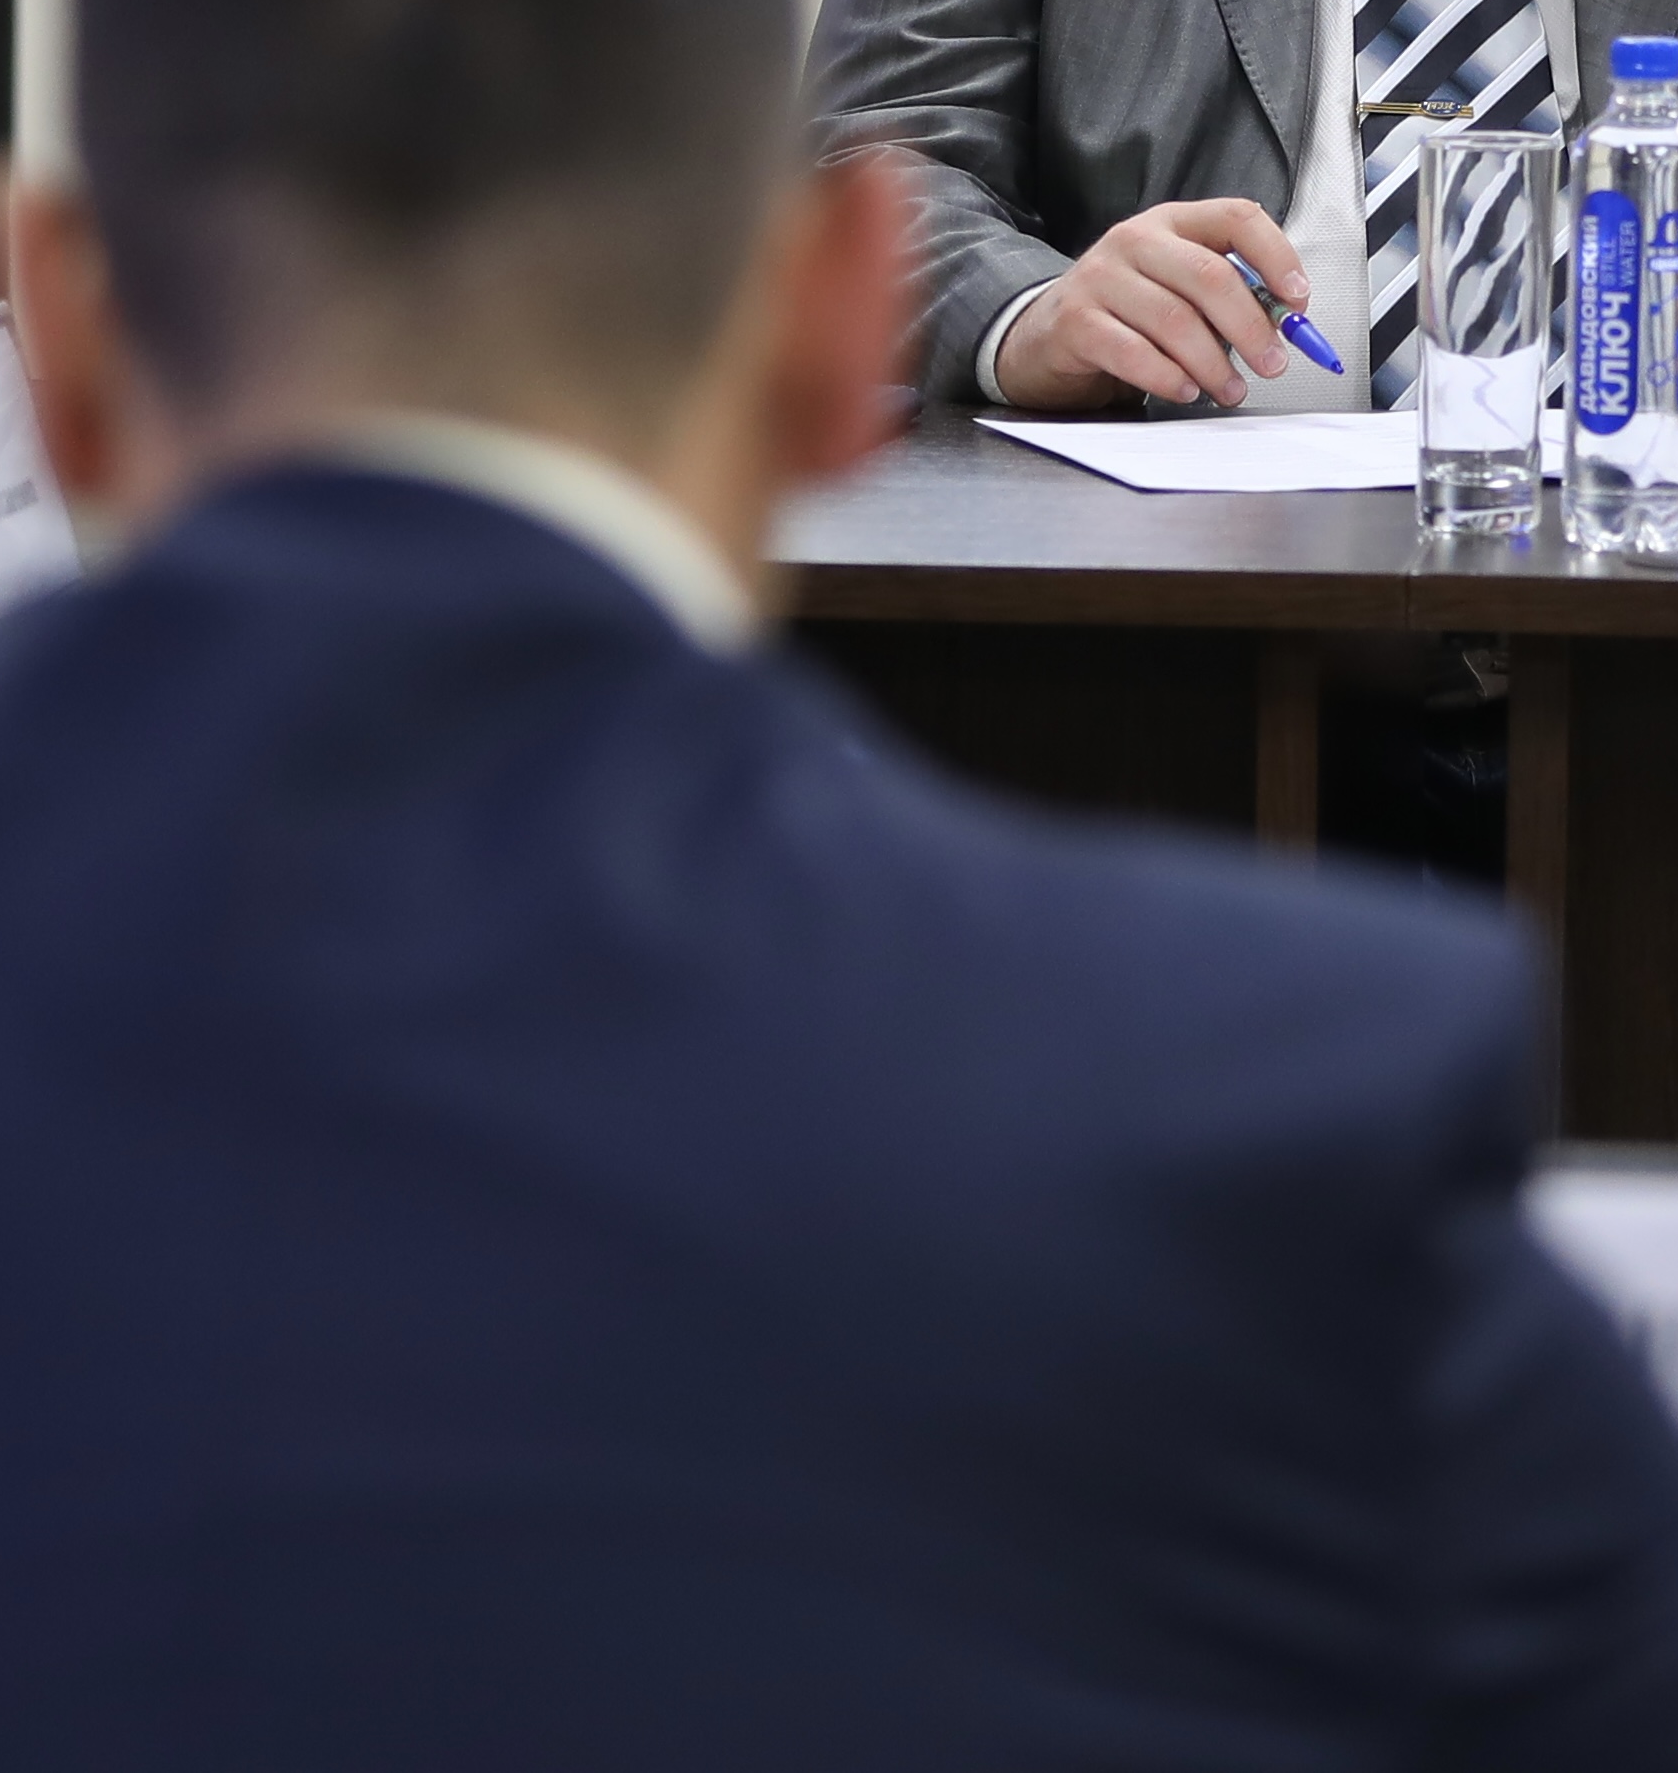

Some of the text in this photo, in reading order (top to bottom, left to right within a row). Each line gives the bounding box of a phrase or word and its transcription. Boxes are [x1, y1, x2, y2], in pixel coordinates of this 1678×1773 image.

[1600, 239, 1617, 287] STILL
[1620, 220, 1637, 288] WATER
[1579, 214, 1600, 415] ДАВЫДОВСКИЙ
[1599, 290, 1631, 416] КЛЮЧ
